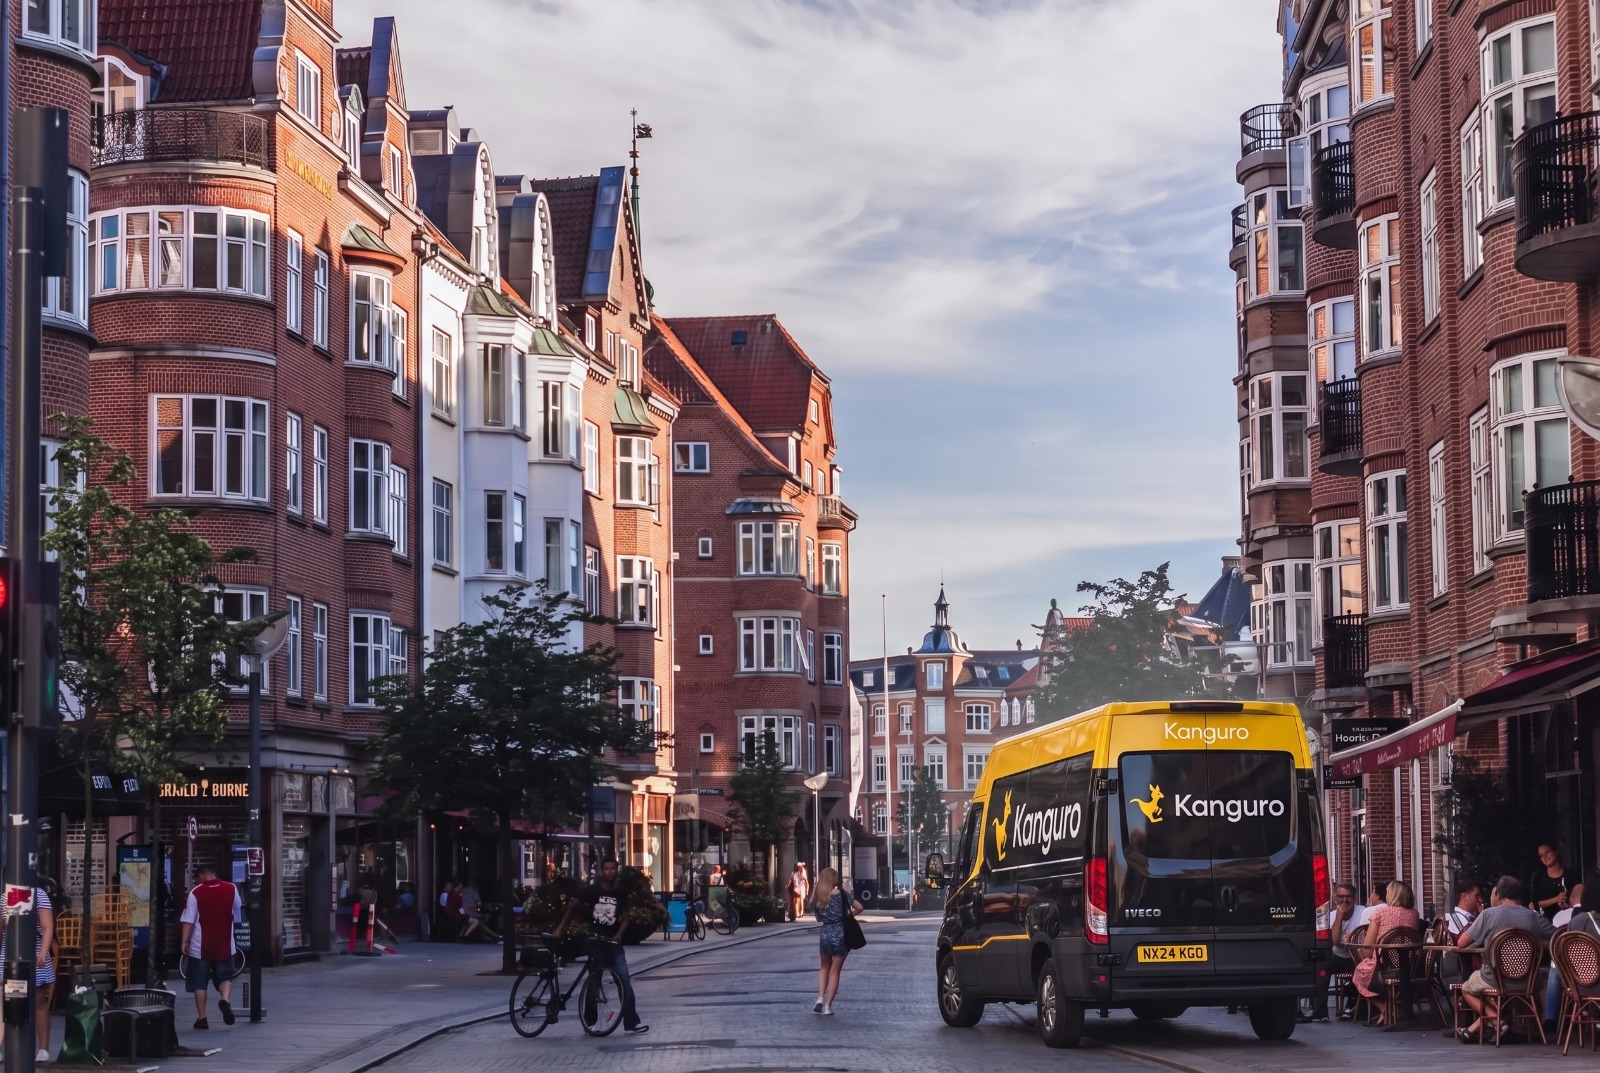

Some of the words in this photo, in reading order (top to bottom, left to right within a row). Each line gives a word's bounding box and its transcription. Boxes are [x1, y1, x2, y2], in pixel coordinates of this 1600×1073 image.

[1164, 722, 1249, 744] Kanguro
[1174, 794, 1285, 823] Kanguro
[1012, 802, 1081, 855] Kanguro
[1124, 908, 1162, 918] IVECO
[1269, 906, 1297, 914] DAILY
[1143, 947, 1176, 960] NX24
[1179, 947, 1204, 959] KGO
